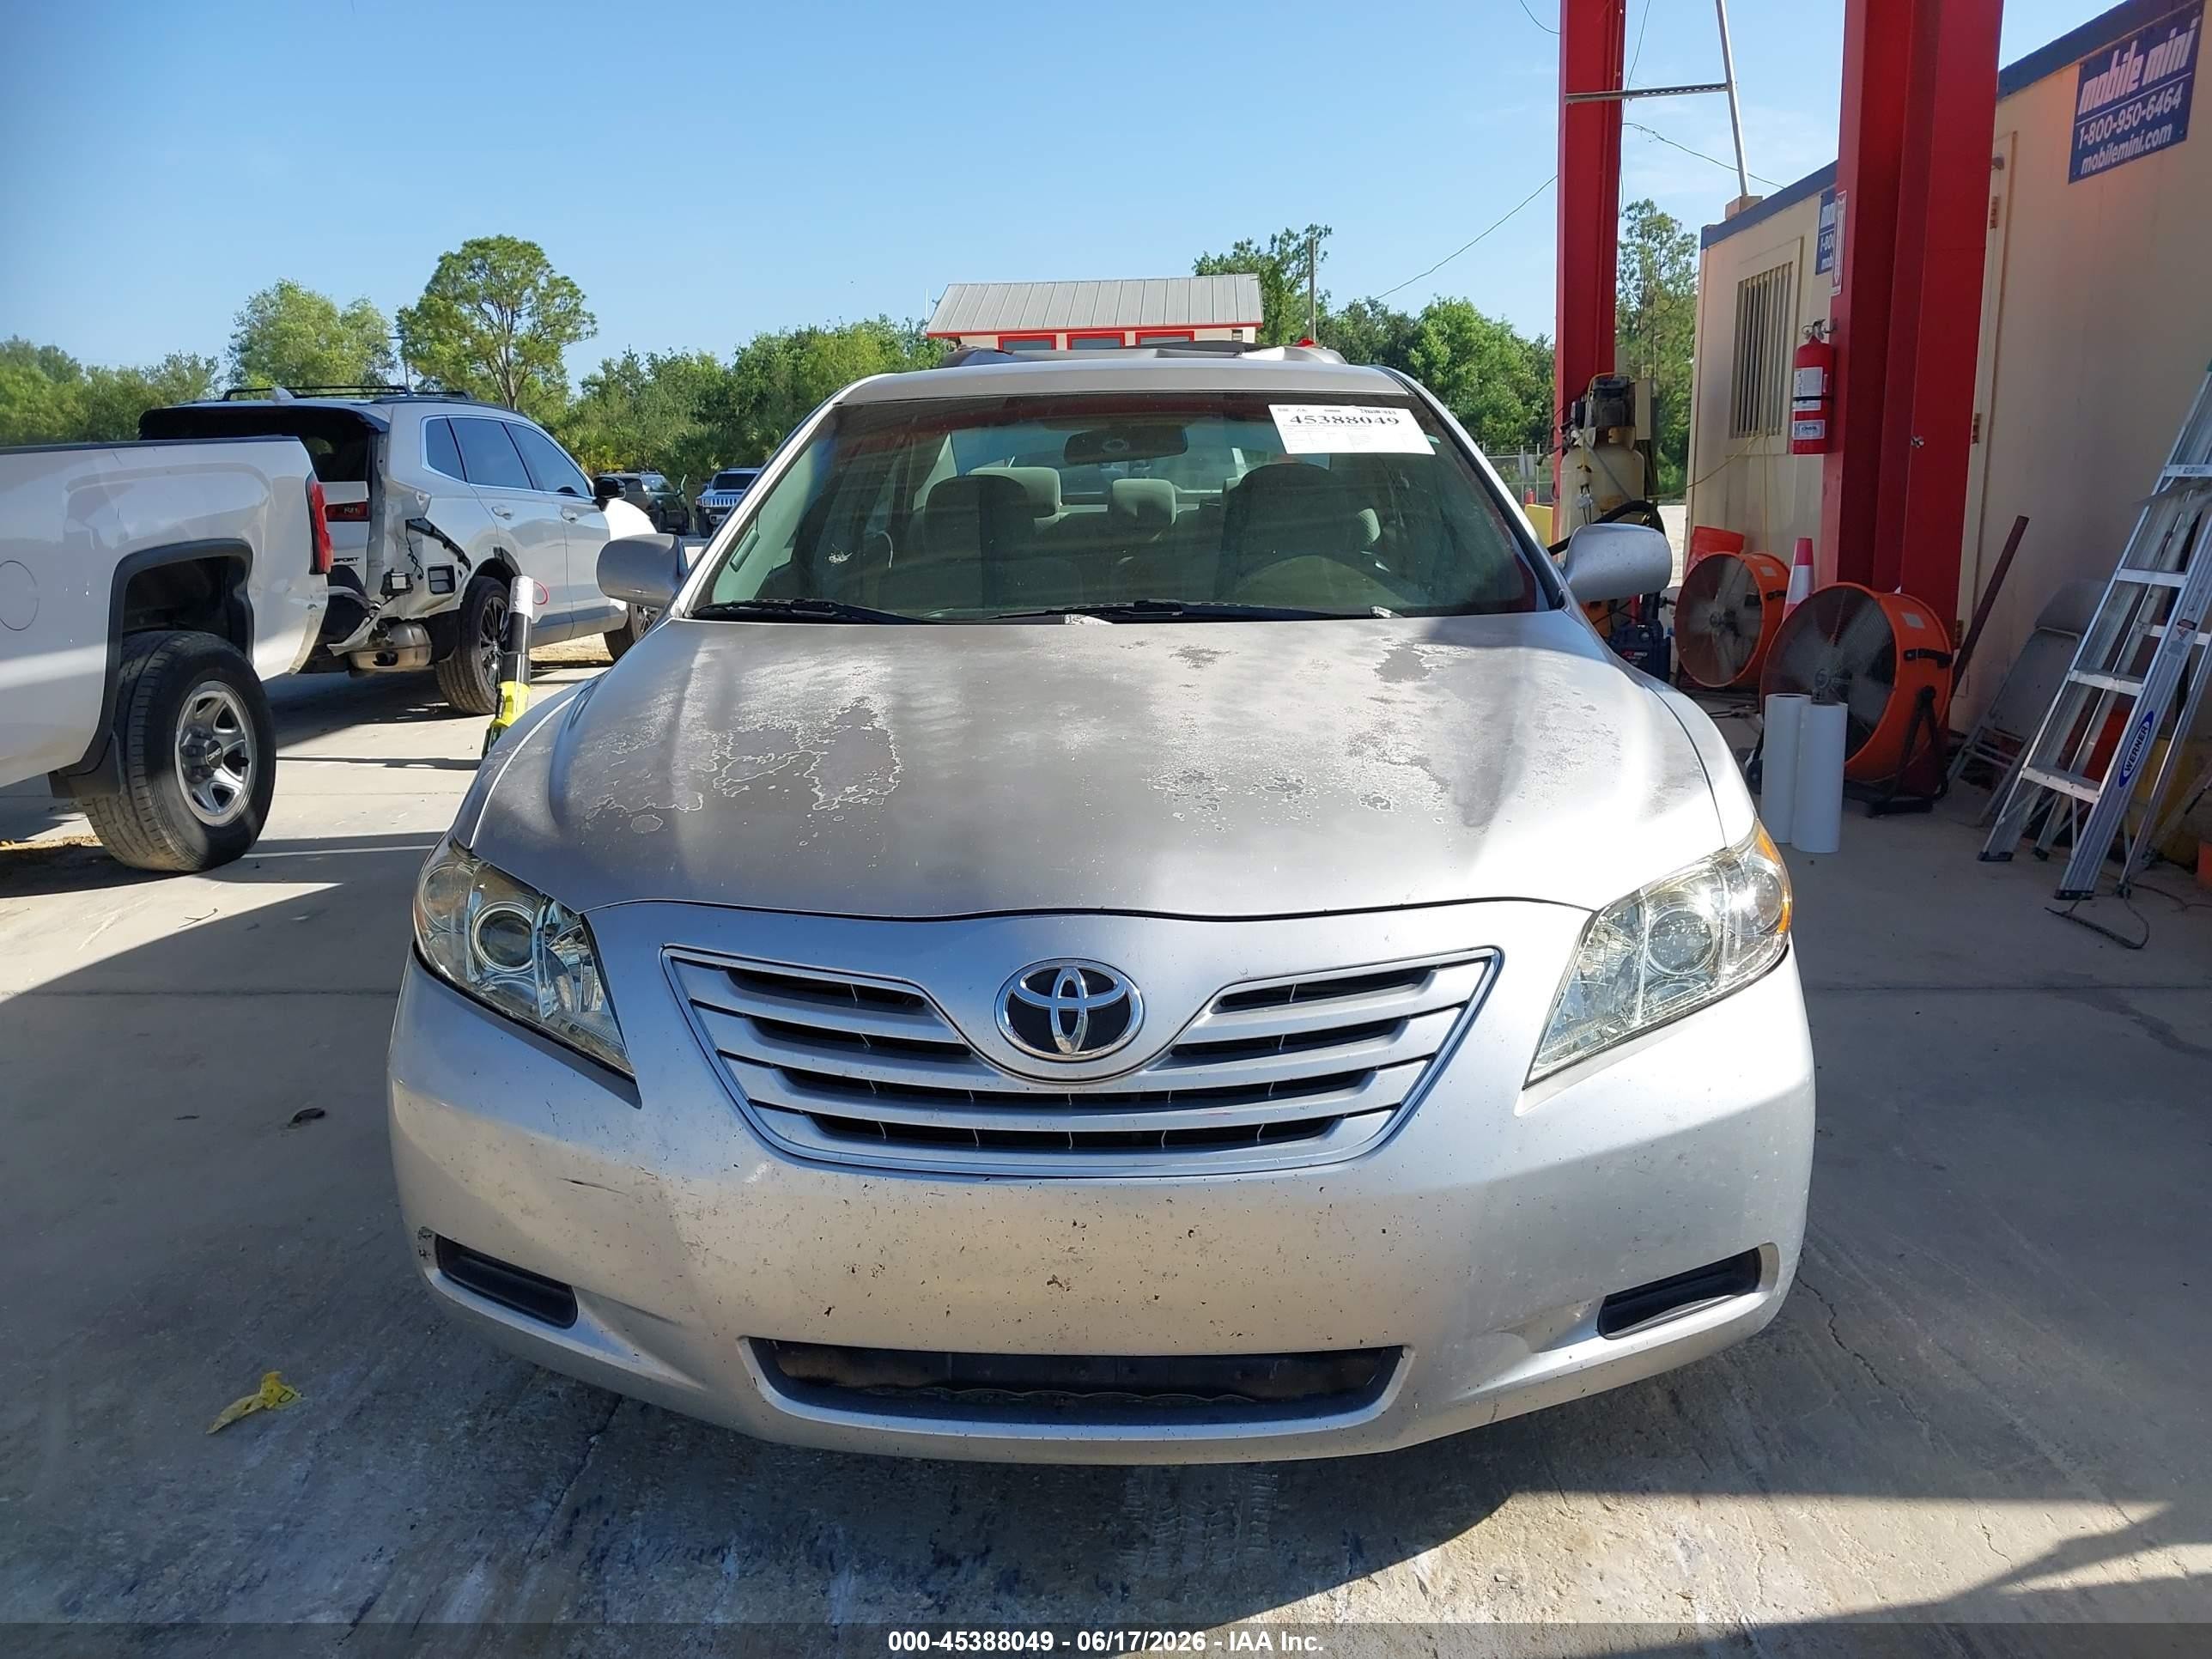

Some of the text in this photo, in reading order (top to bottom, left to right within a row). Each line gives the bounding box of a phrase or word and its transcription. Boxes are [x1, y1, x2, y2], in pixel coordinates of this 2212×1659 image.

[2078, 15, 2202, 115] mobile mini
[2079, 82, 2184, 149] 1-800-950-6464
[2081, 124, 2172, 174] mobilemini.com
[1290, 415, 1400, 425] 45388049
[2124, 726, 2148, 772] WERNER
